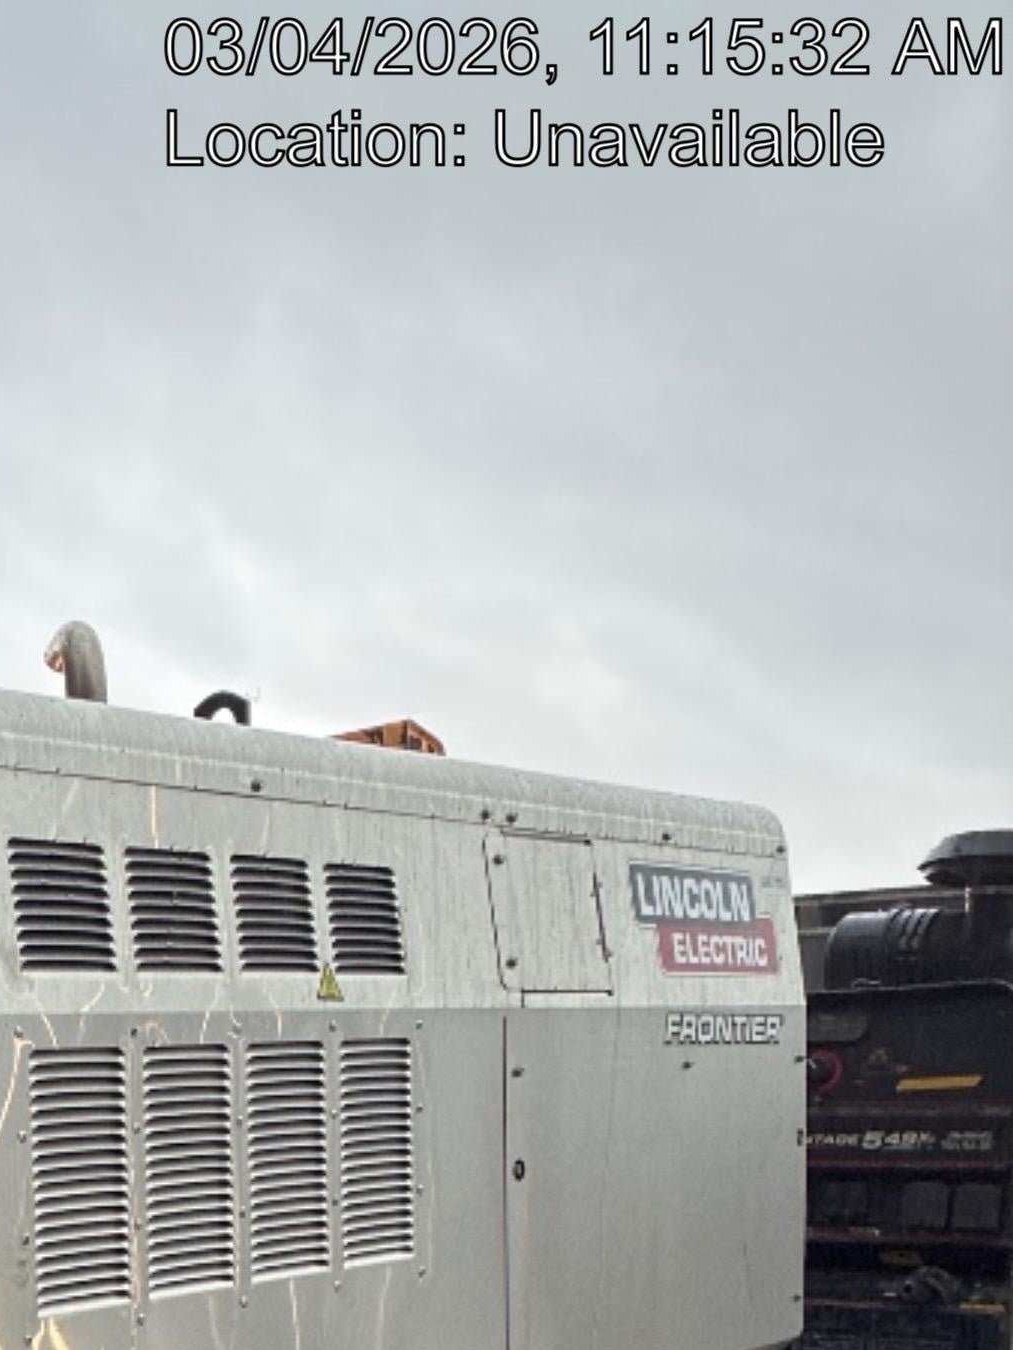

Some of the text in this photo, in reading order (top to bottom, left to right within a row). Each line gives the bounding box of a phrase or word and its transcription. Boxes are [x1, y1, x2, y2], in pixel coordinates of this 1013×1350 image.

[636, 874, 751, 922] LINCOLN
[672, 932, 768, 967] ELECTRIC
[664, 1012, 784, 1045] FRONTIER
